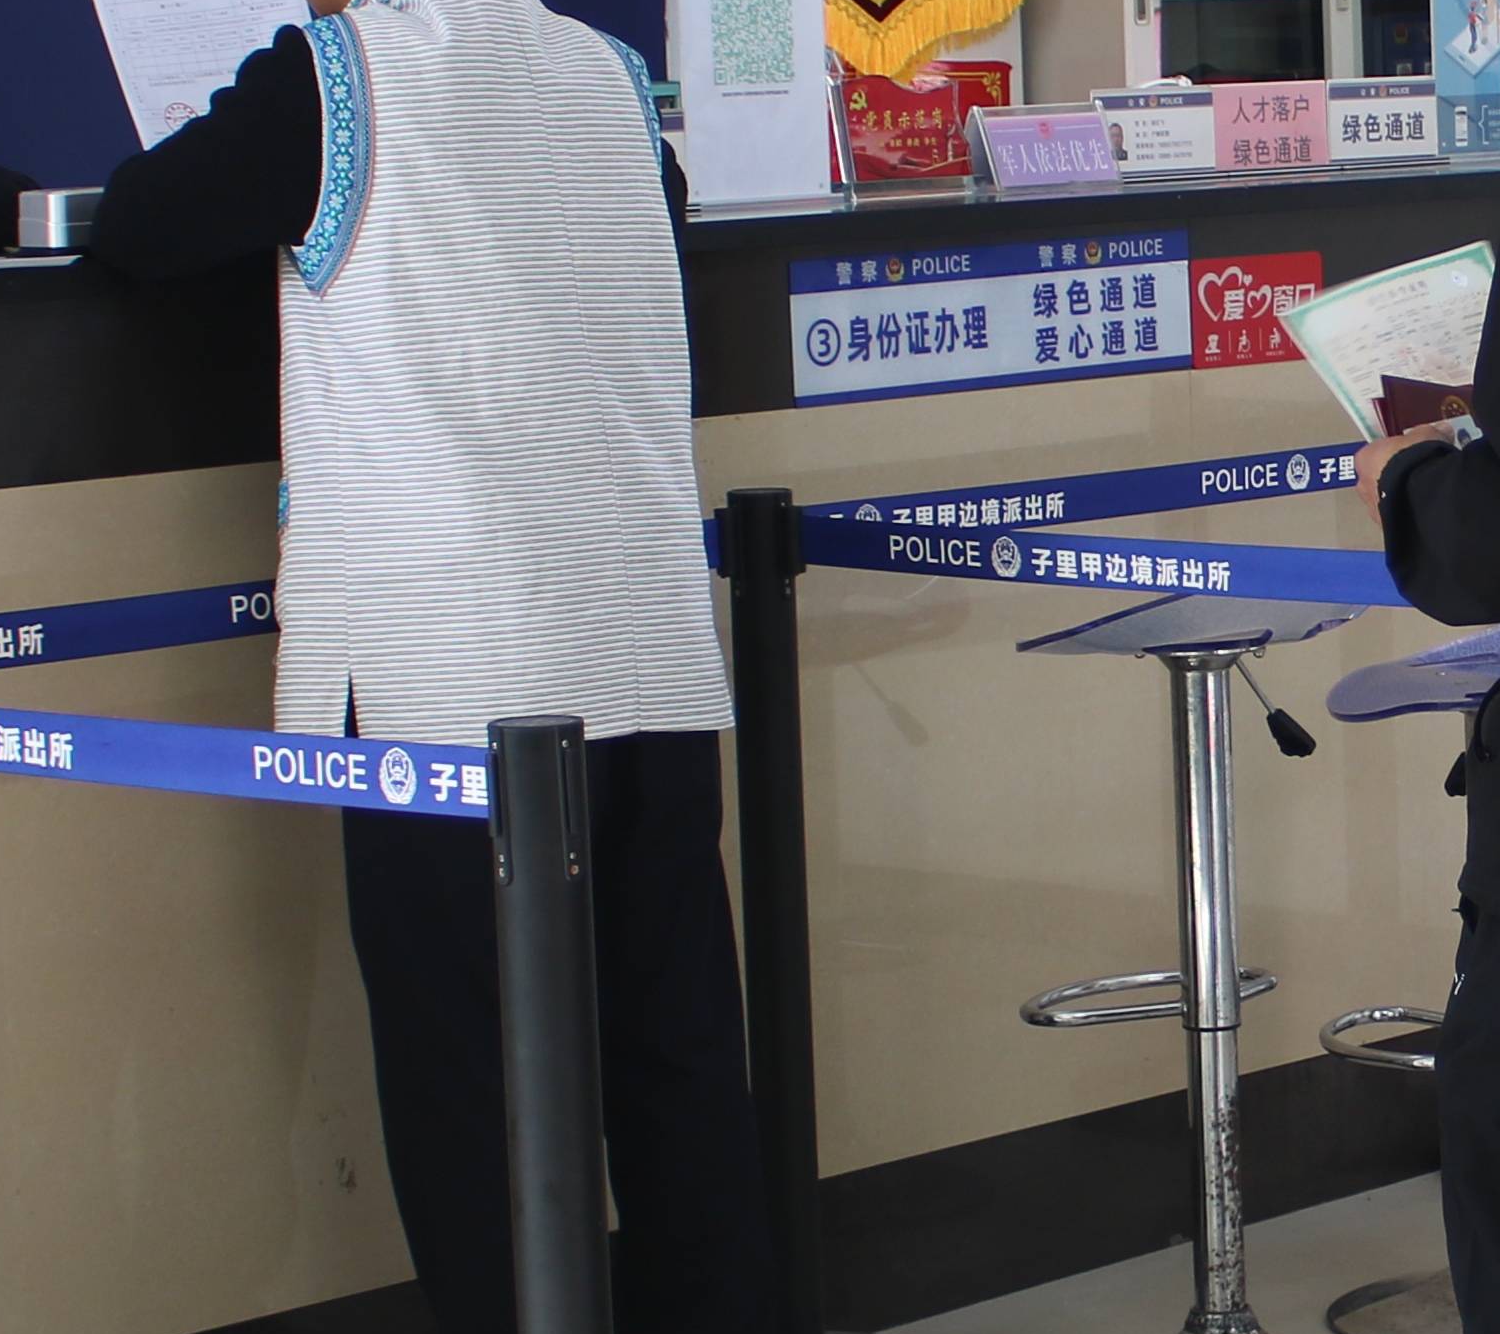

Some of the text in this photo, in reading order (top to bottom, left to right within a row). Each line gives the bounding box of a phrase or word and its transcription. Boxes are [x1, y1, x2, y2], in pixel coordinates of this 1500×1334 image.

[1160, 95, 1183, 105] POLICE
[1232, 93, 1310, 125] 人才落户
[1342, 111, 1425, 144] 绿色通道
[999, 138, 1109, 176] 军人依法优先
[1233, 135, 1312, 167] 绿色通道
[1037, 238, 1164, 267] 警察 POLICE
[836, 254, 971, 286] 警察 POLICE
[1033, 273, 1157, 319] 绿色通道
[1035, 317, 1160, 364] 爱心通道
[1201, 463, 1279, 495] POLICE
[889, 534, 1232, 593] POLICE 子里甲边境派出所
[253, 745, 368, 791] POLICE
